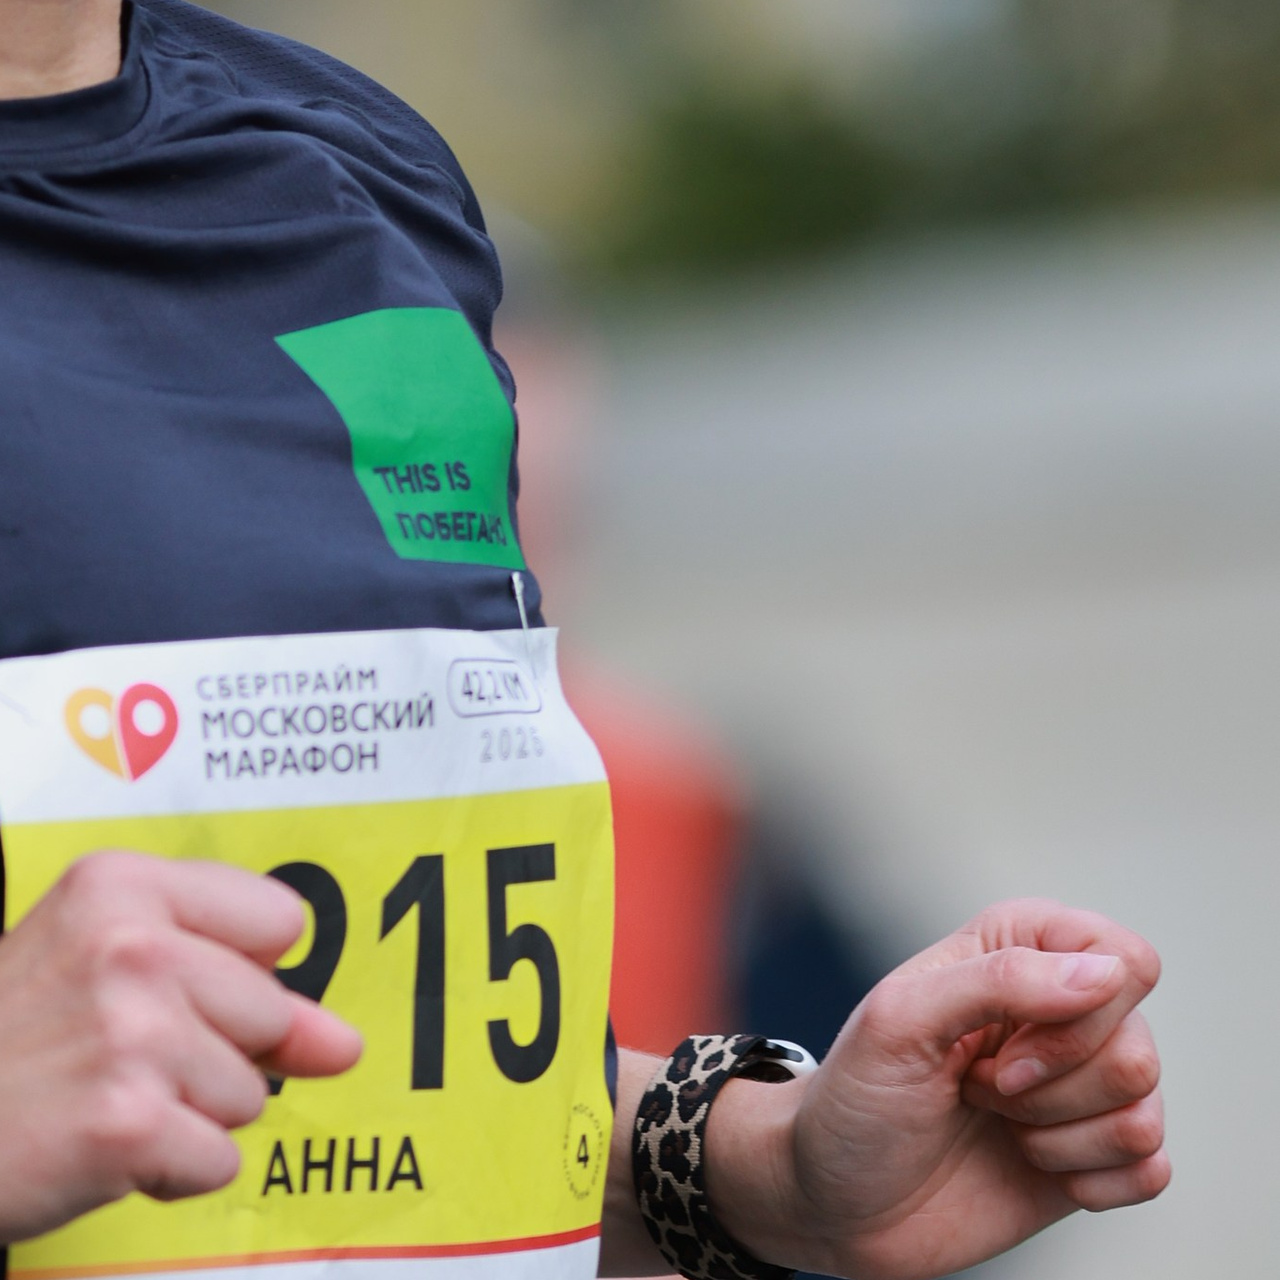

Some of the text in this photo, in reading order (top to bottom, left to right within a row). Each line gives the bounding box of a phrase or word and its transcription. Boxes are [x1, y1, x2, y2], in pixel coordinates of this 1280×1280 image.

[373, 460, 471, 494] THIS IS
[197, 667, 379, 700] СБЕРПРАЙМ
[201, 698, 435, 739] МОСКОВСКИЙ
[204, 742, 380, 780] МАРАФОН
[261, 1135, 424, 1196] АННА
[576, 1134, 590, 1169] 4
